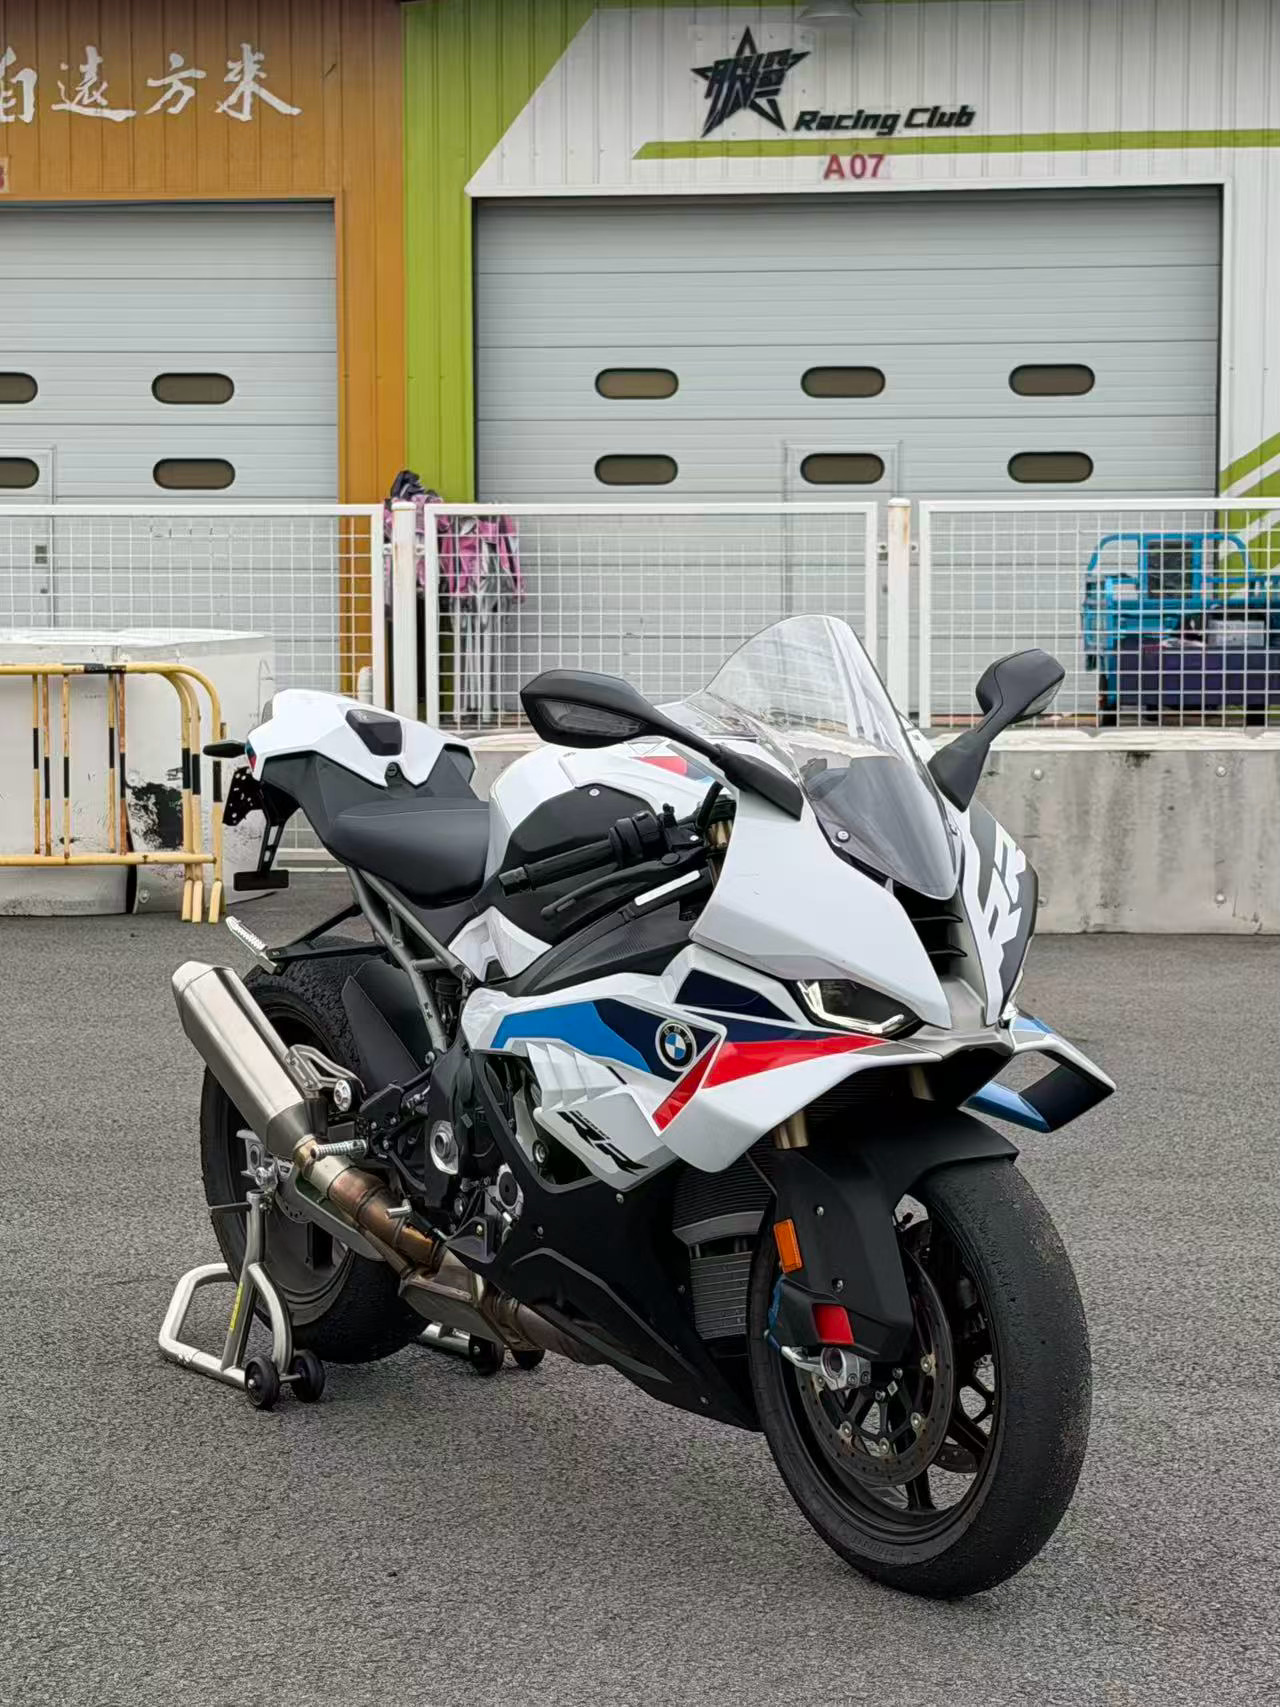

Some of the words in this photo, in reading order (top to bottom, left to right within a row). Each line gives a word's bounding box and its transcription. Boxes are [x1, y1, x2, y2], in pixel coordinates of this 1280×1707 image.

[793, 109, 900, 136] Racing
[904, 105, 976, 129] Club
[824, 154, 886, 180] A07
